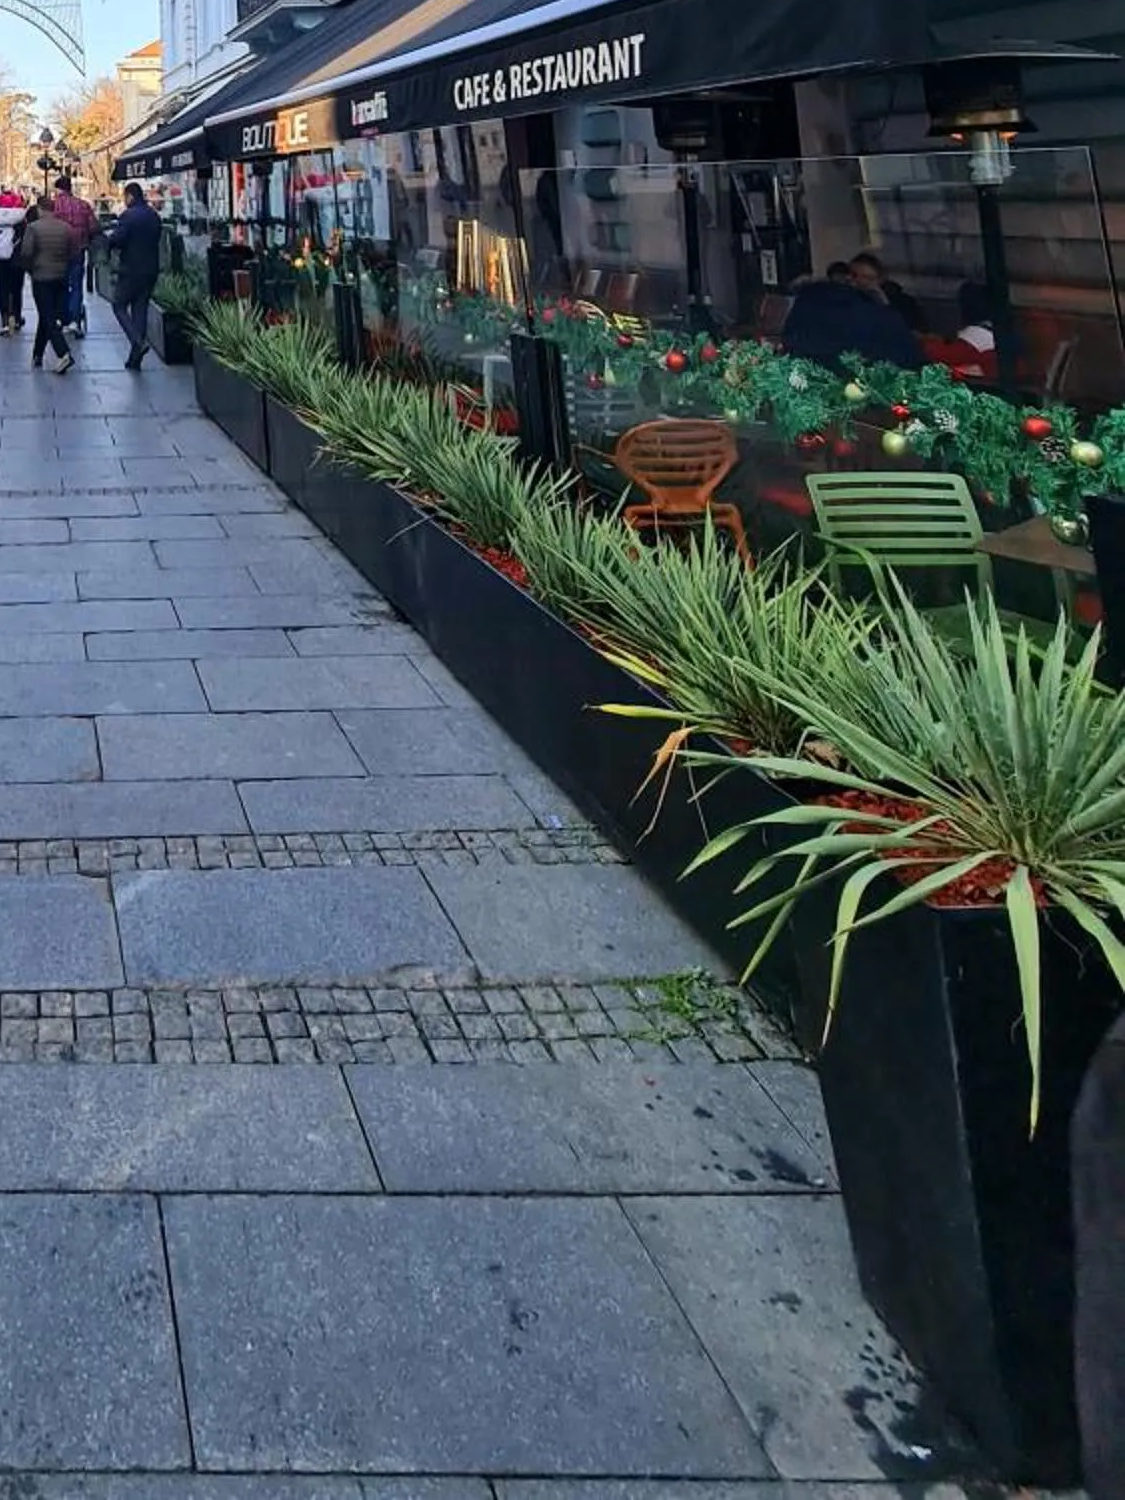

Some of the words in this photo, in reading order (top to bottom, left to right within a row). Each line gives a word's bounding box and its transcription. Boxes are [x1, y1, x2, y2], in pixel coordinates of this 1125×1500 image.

[454, 73, 490, 110] CAFE
[493, 69, 507, 104] &
[509, 33, 646, 100] RESTAURANT
[242, 111, 309, 153] BOUTIQUE
